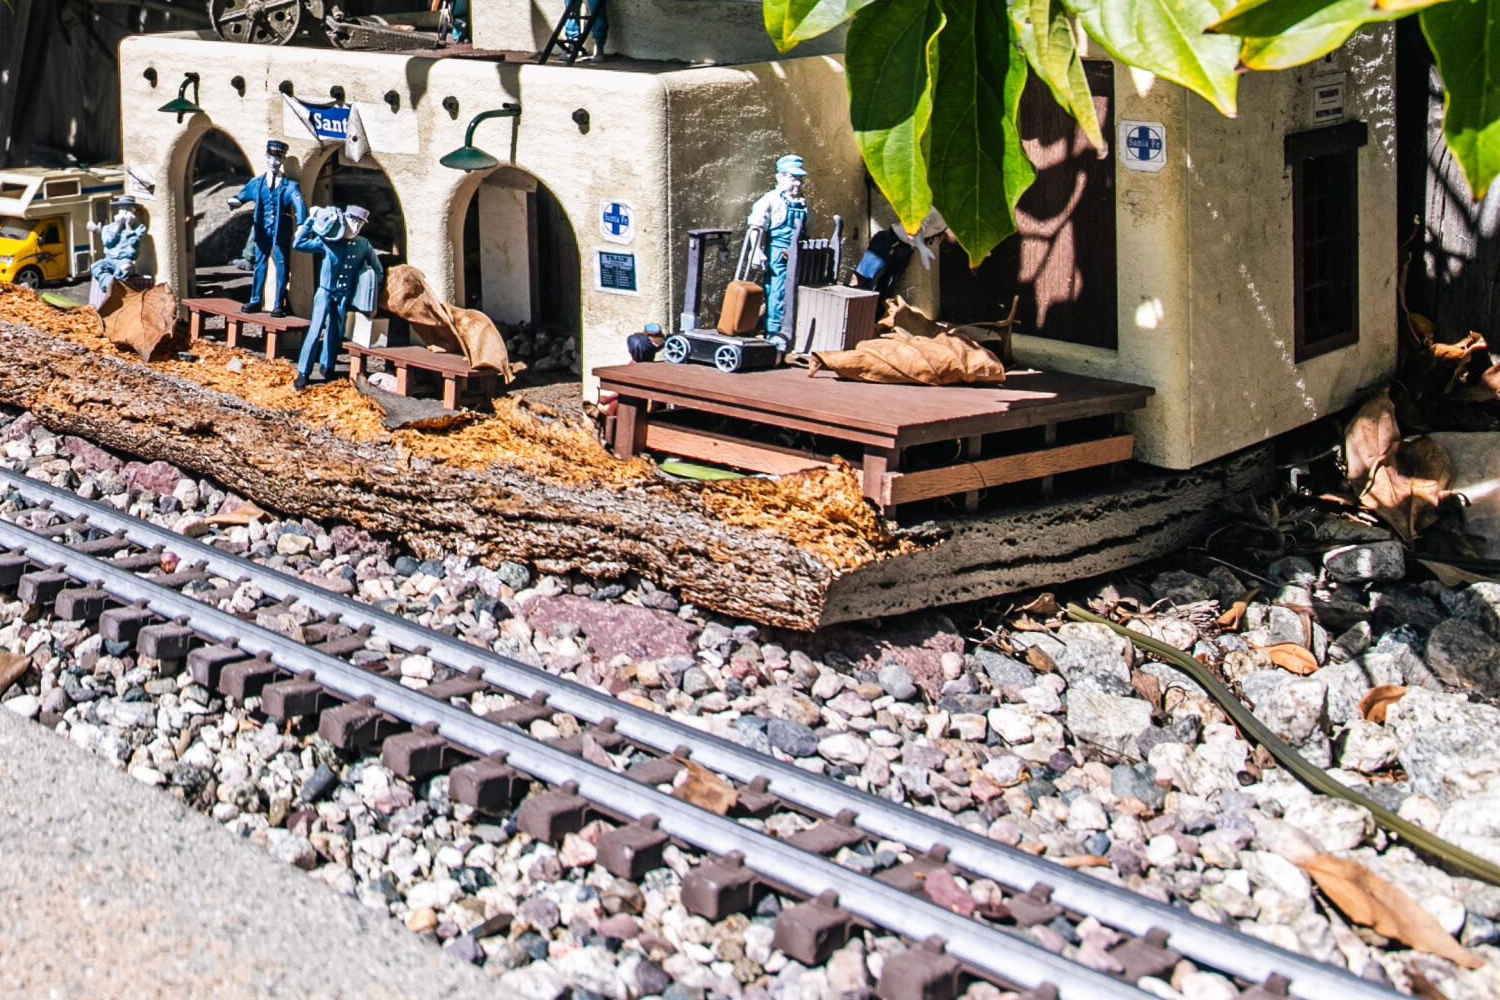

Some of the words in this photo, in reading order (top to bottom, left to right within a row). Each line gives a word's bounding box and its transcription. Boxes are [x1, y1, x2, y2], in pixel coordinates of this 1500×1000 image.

[1128, 138, 1149, 148] Santa
[1151, 140, 1160, 149] Fe
[606, 255, 628, 263] TRAIN
